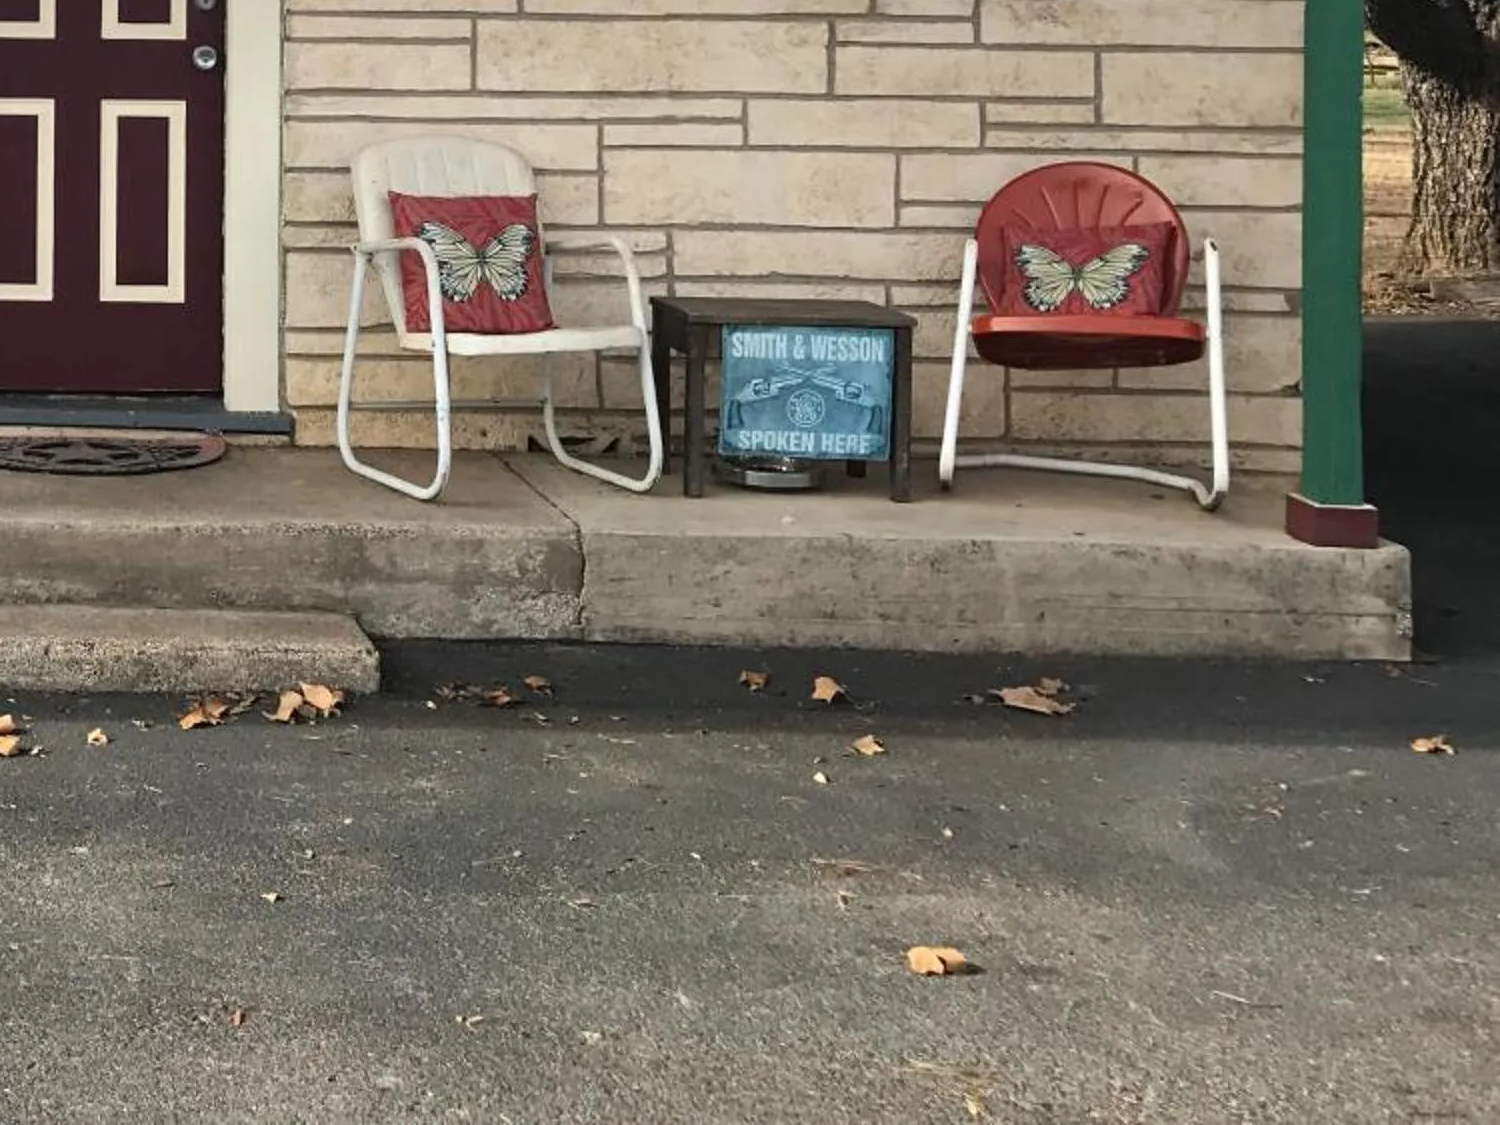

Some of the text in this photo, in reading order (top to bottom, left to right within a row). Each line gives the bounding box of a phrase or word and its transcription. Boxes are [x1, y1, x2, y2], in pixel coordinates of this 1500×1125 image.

[731, 331, 885, 363] SMITH & WESSON
[738, 429, 873, 455] SPOKEN HERE
